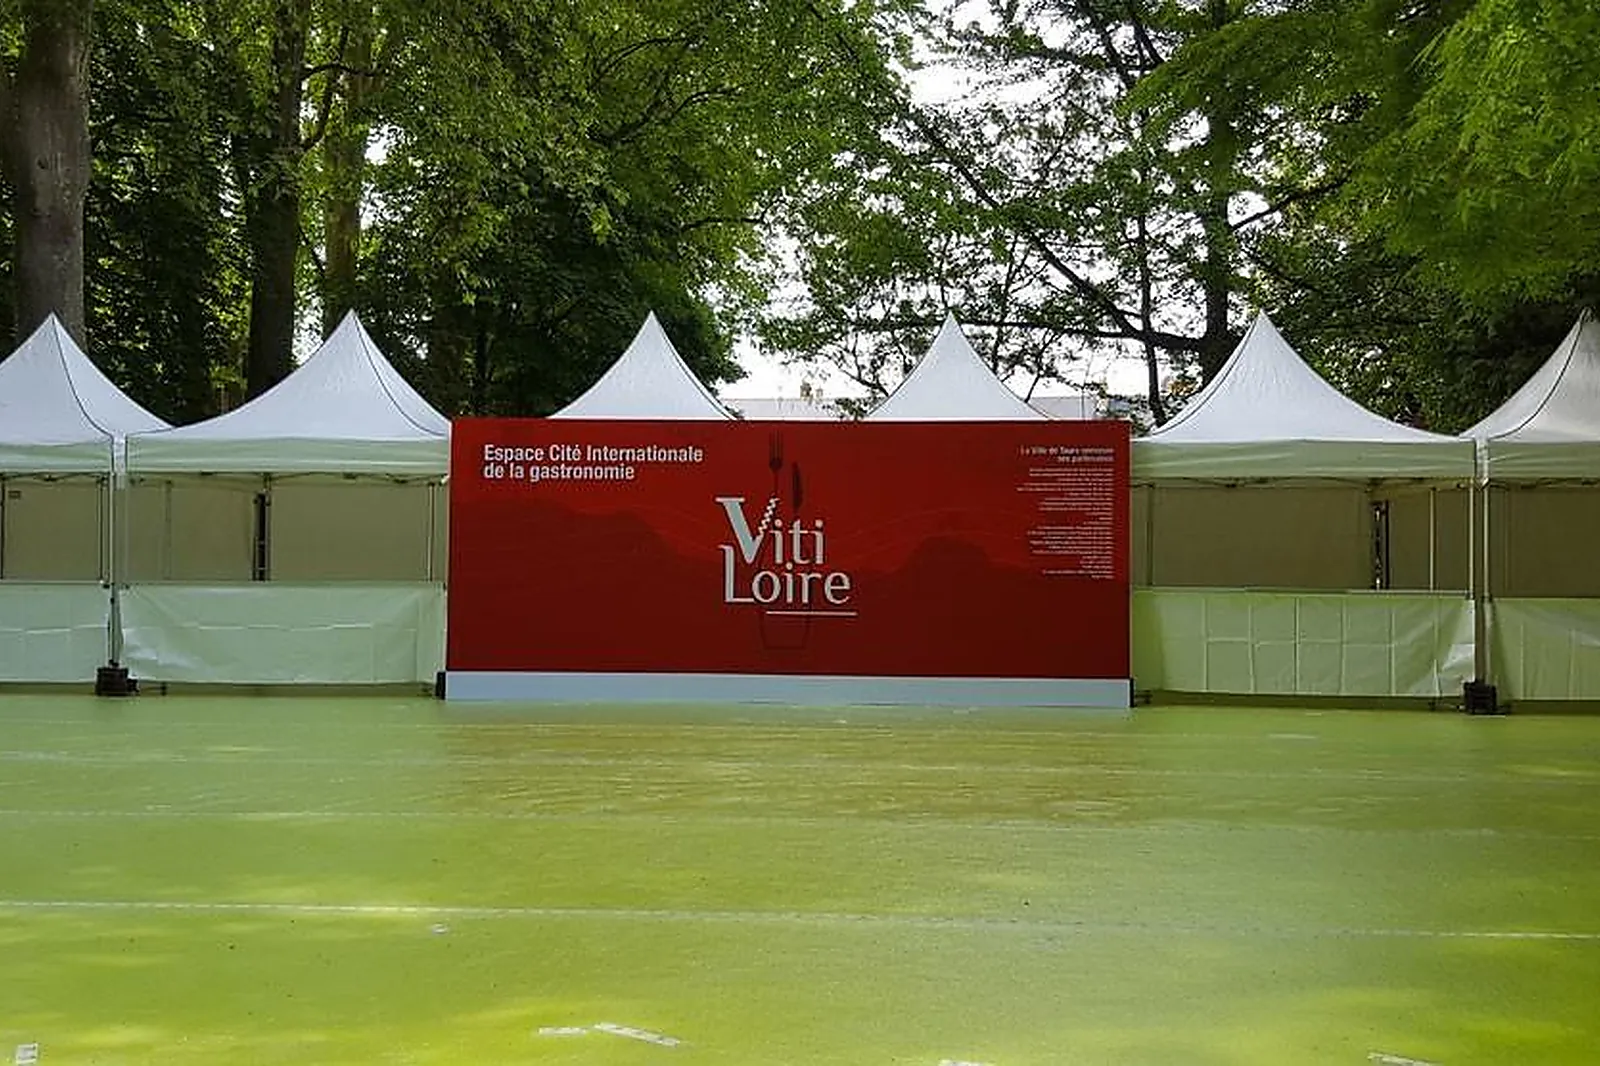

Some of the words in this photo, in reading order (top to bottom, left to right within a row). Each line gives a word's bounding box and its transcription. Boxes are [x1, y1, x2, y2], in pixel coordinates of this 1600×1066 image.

[483, 462, 504, 479] de
[509, 463, 525, 479] la
[529, 463, 635, 482] gastronomie
[484, 445, 544, 463] Espace
[550, 444, 582, 461] Cité
[586, 445, 703, 462] Internationale
[715, 496, 825, 564] Viti
[718, 545, 851, 605] Loire
